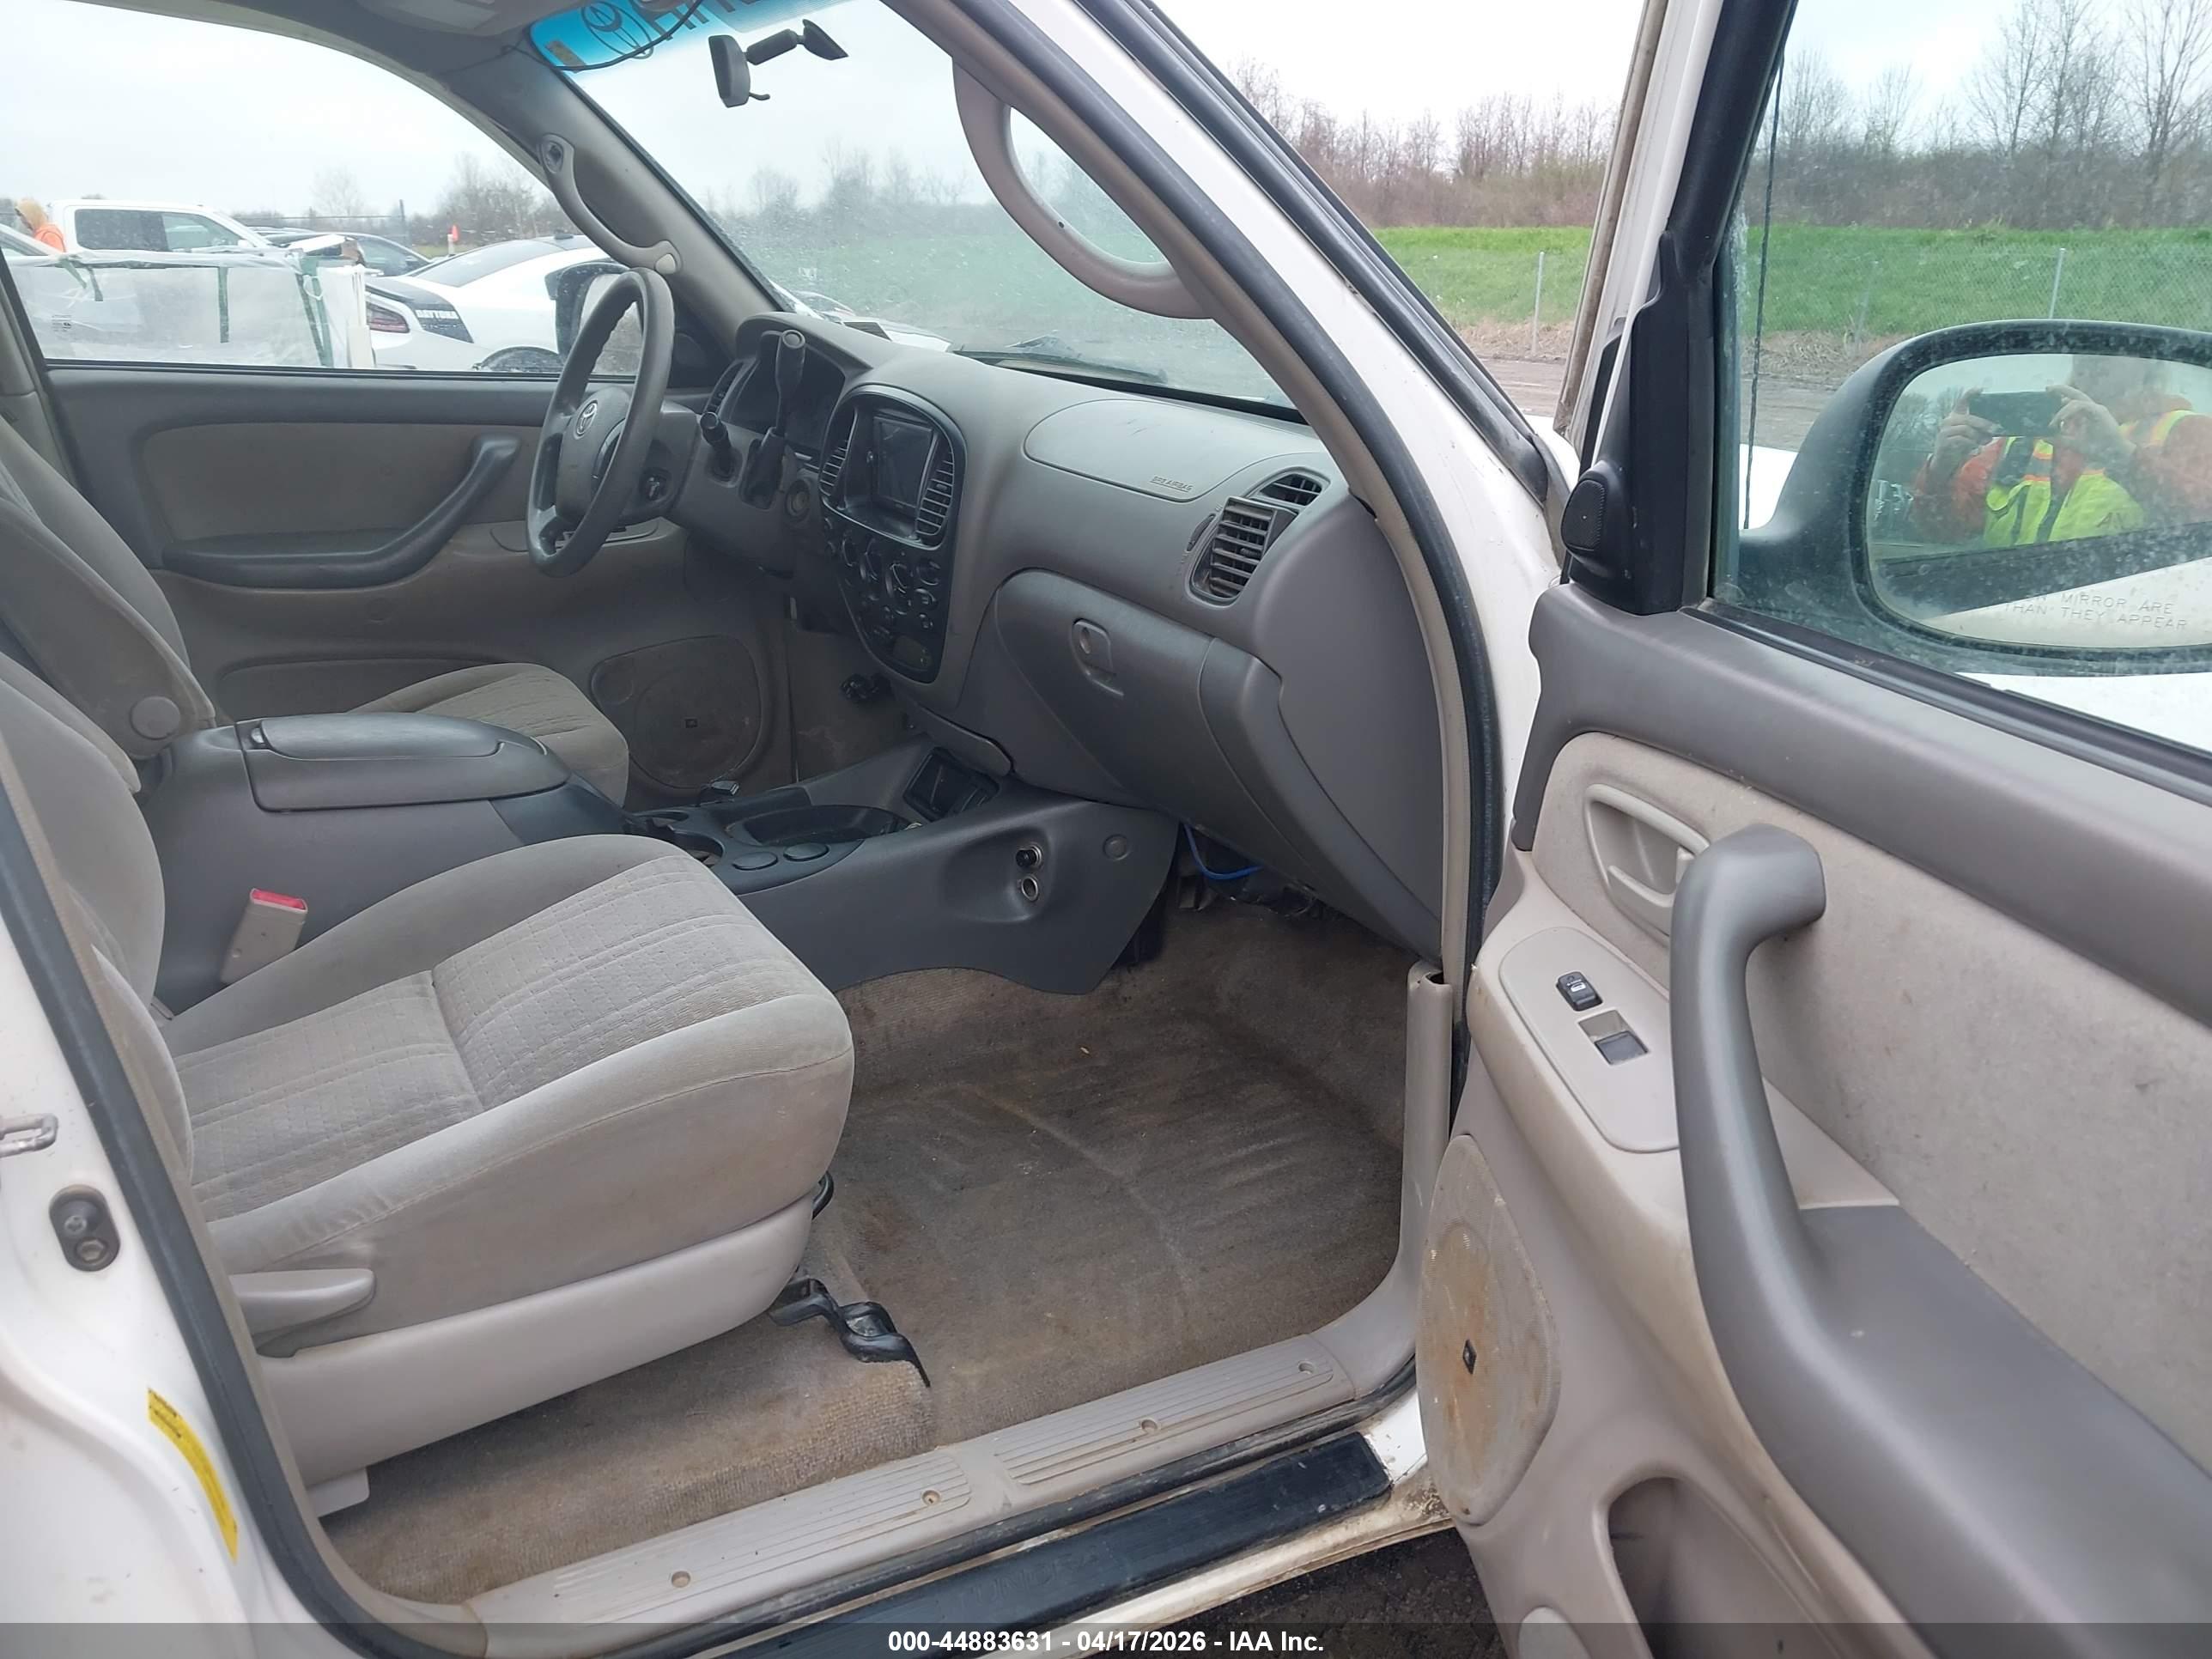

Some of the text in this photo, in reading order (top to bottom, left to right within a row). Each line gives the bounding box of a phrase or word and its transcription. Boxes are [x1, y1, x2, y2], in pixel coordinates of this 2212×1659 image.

[1165, 479, 1193, 491] AIRBAG
[2061, 592, 2127, 610] MIRROR
[2138, 599, 2173, 614] ARE
[2005, 603, 2188, 629] THAN THEY APPEAR
